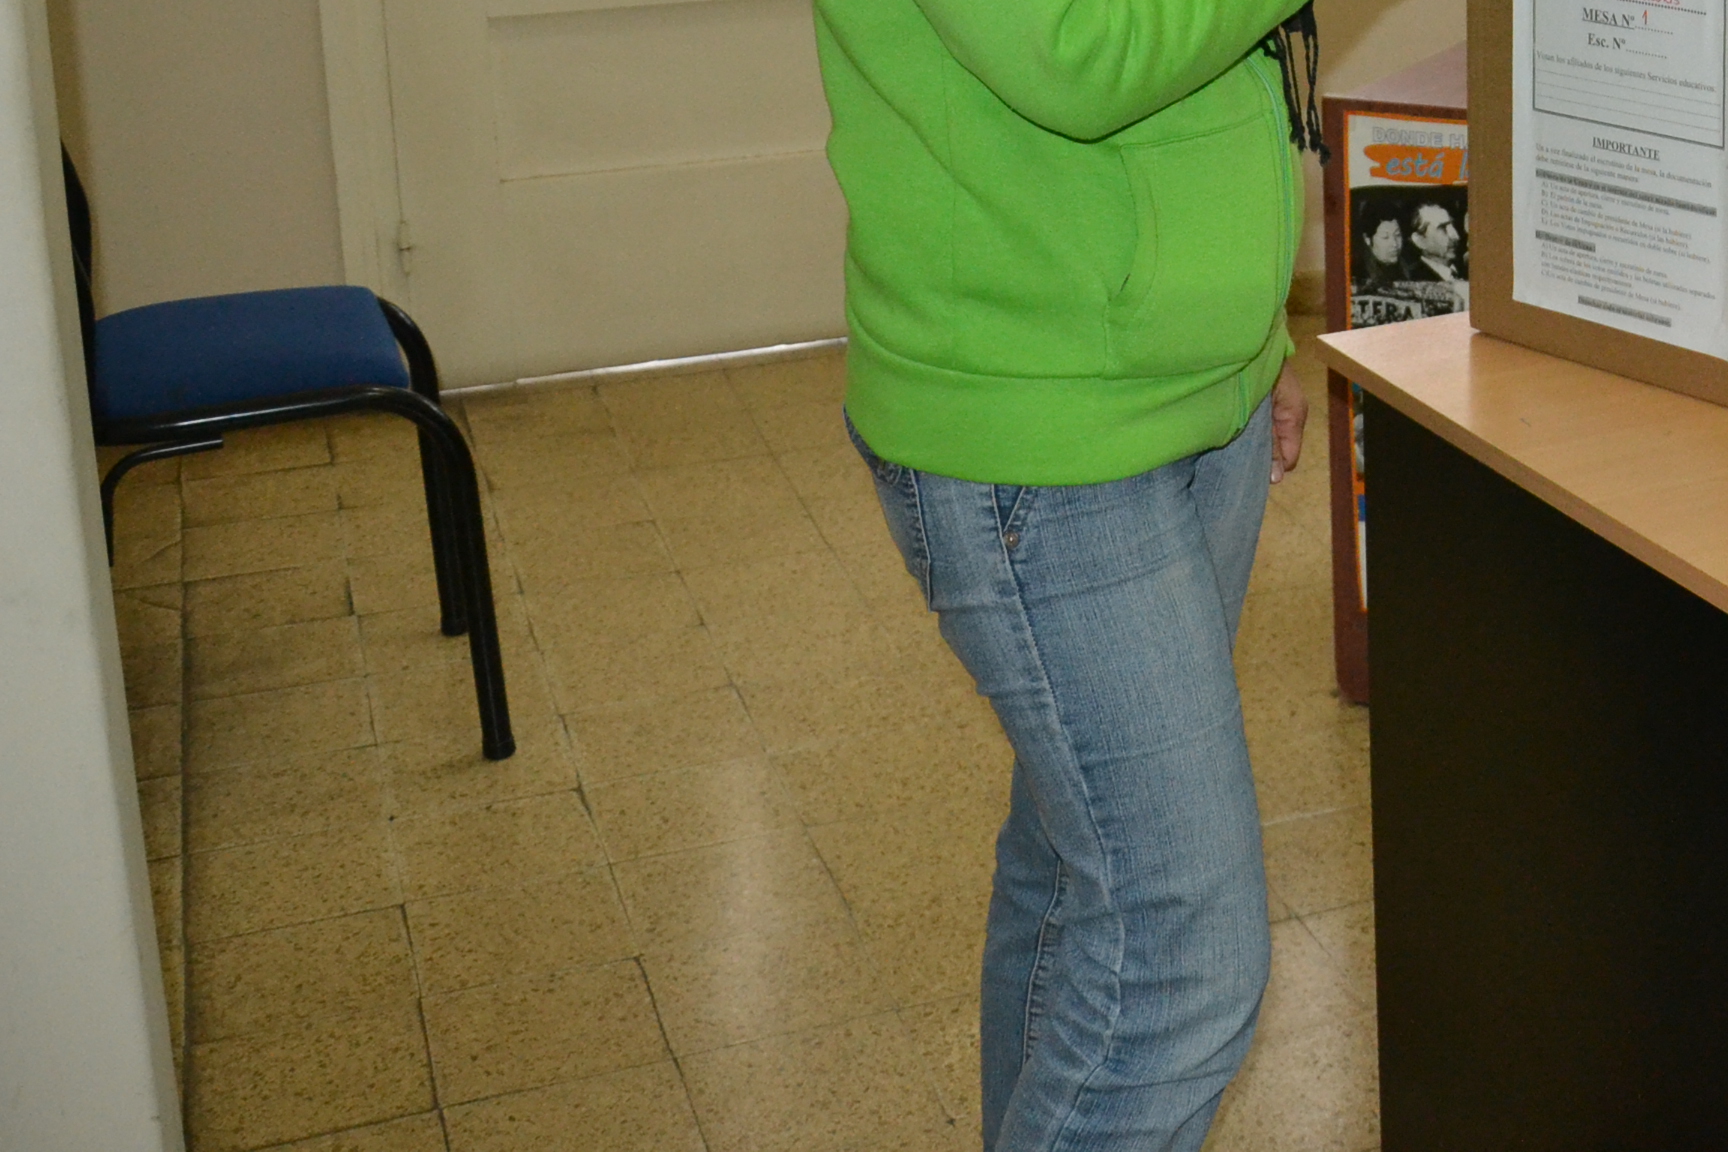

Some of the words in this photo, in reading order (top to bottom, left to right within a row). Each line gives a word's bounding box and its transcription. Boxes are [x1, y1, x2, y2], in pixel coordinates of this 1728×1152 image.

[1582, 7, 1618, 26] MESA
[1641, 8, 1649, 25] 1
[1588, 32, 1609, 48] Esc.
[1556, 55, 1566, 64] los
[1594, 62, 1602, 71] de
[1604, 64, 1613, 73] los
[1647, 72, 1677, 86] Servicios
[1372, 126, 1443, 148] DONDE
[1449, 133, 1468, 150] H
[1592, 136, 1660, 160] IMPORTANTE
[1386, 152, 1445, 179] está
[1459, 151, 1468, 180] l
[1352, 299, 1414, 321] TERA
